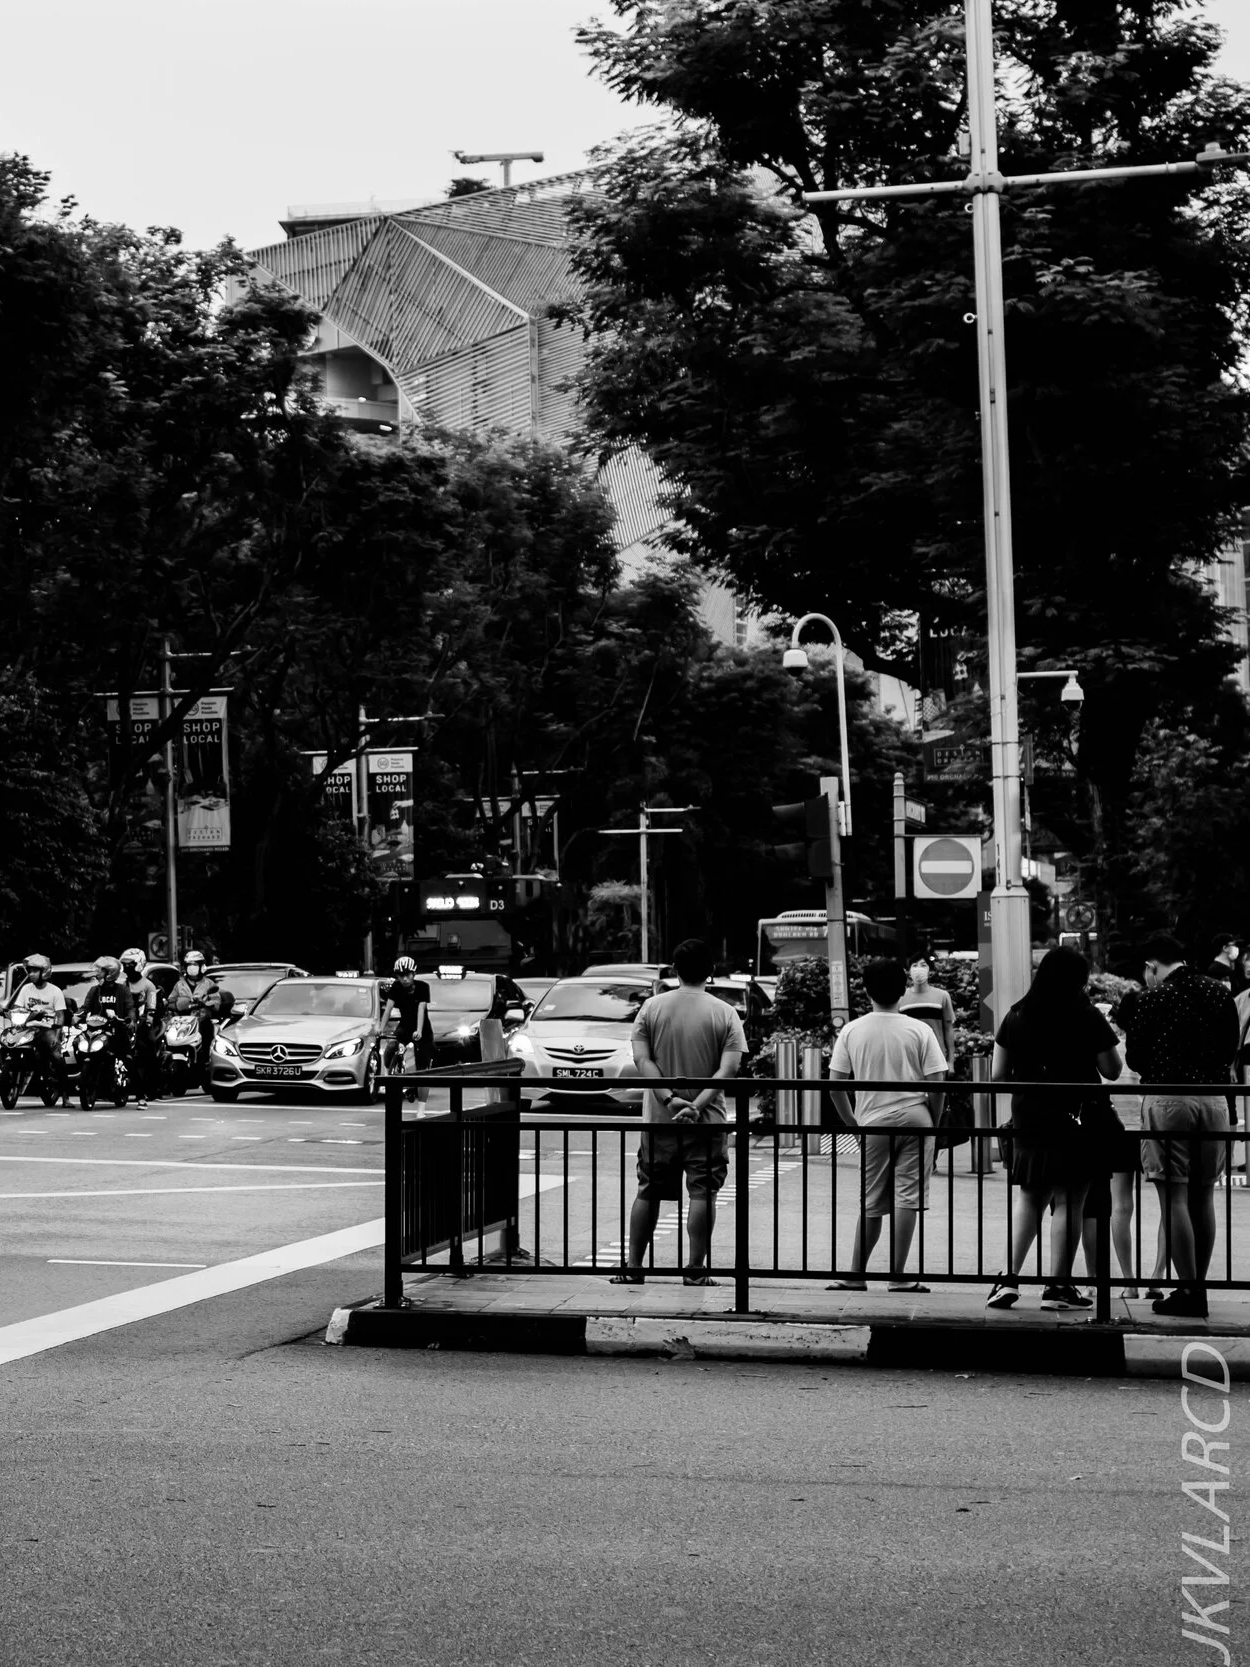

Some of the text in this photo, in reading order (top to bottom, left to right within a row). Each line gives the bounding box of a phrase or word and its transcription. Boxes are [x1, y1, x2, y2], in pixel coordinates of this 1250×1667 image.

[115, 722, 152, 734] SOP
[183, 722, 220, 733] SHOP
[183, 735, 221, 744] LOCAL
[323, 775, 351, 786] HOP
[375, 774, 407, 784] SHOP
[375, 784, 407, 793] LOCAL
[490, 900, 505, 910] D3
[255, 1066, 302, 1076] SKR3726U
